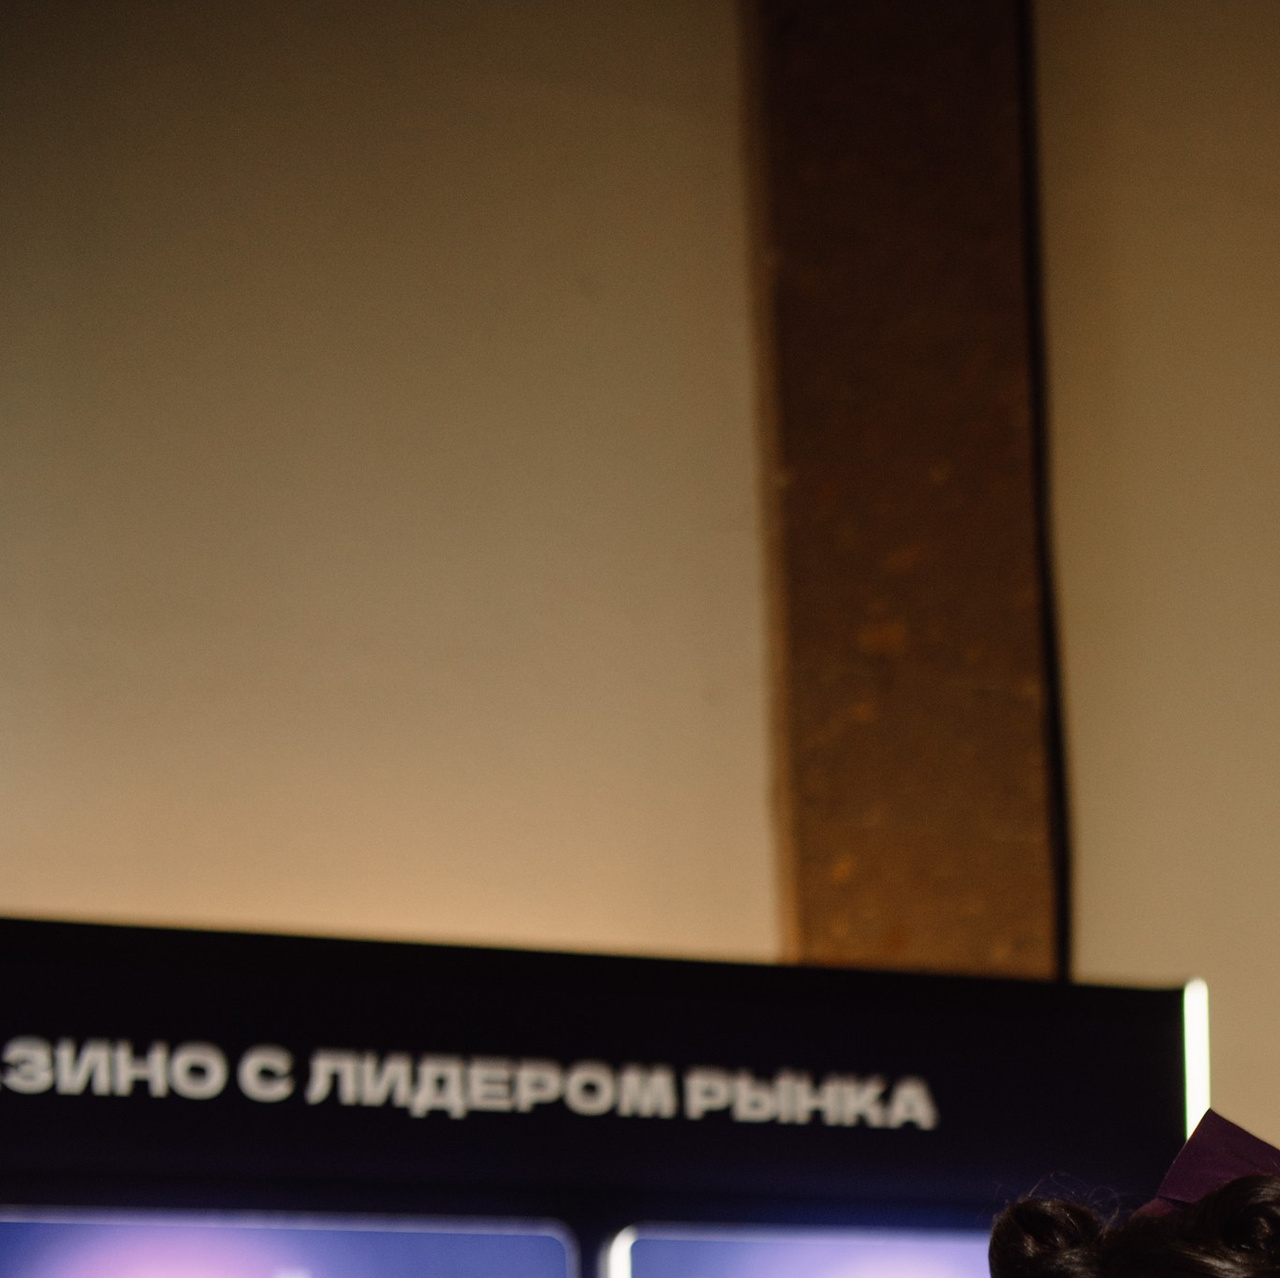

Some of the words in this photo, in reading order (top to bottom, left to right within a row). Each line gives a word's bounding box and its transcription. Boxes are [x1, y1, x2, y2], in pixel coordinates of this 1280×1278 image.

[2, 1037, 229, 1099] ЗИНО
[236, 1044, 294, 1103] С
[305, 1048, 677, 1120] ЛИДЕРОМ
[684, 1067, 937, 1130] РЫНКА
